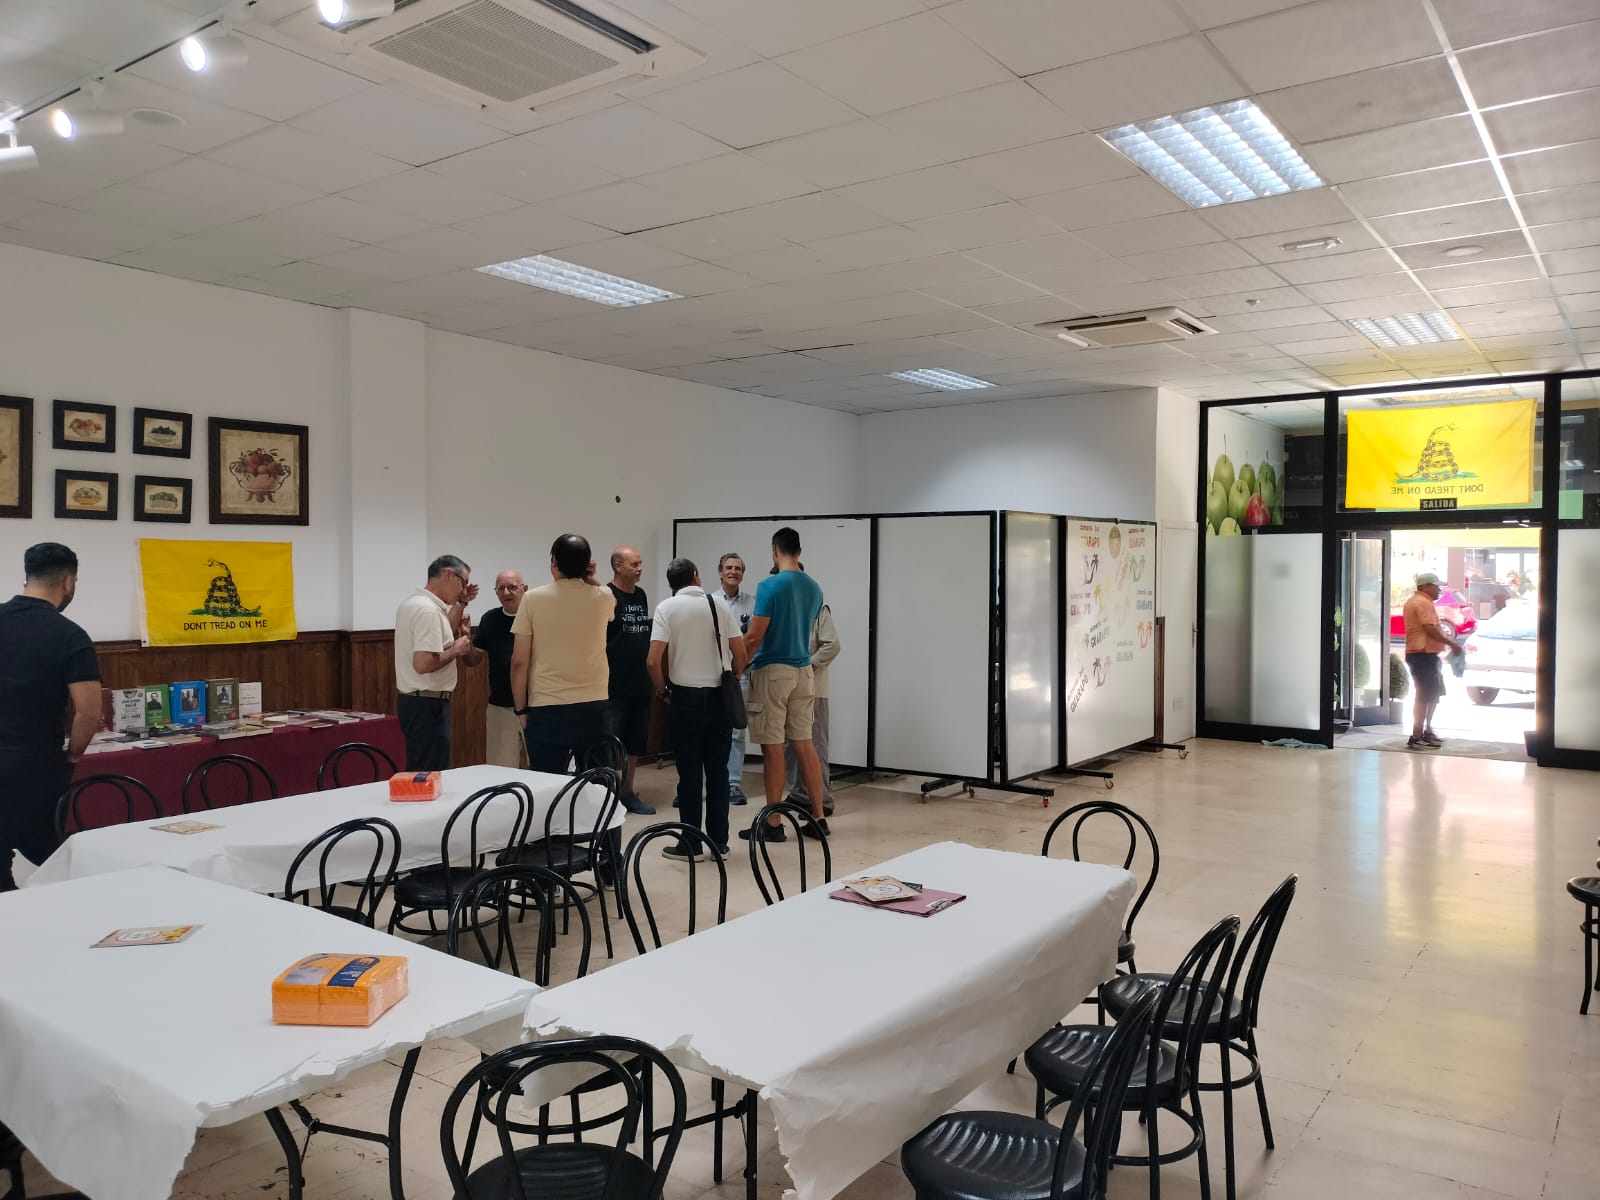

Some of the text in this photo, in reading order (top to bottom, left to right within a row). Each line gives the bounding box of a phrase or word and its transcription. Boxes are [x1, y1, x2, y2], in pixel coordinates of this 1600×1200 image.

[1422, 499, 1455, 509] SALIDA
[183, 619, 267, 631] DONT TREAD ON ME
